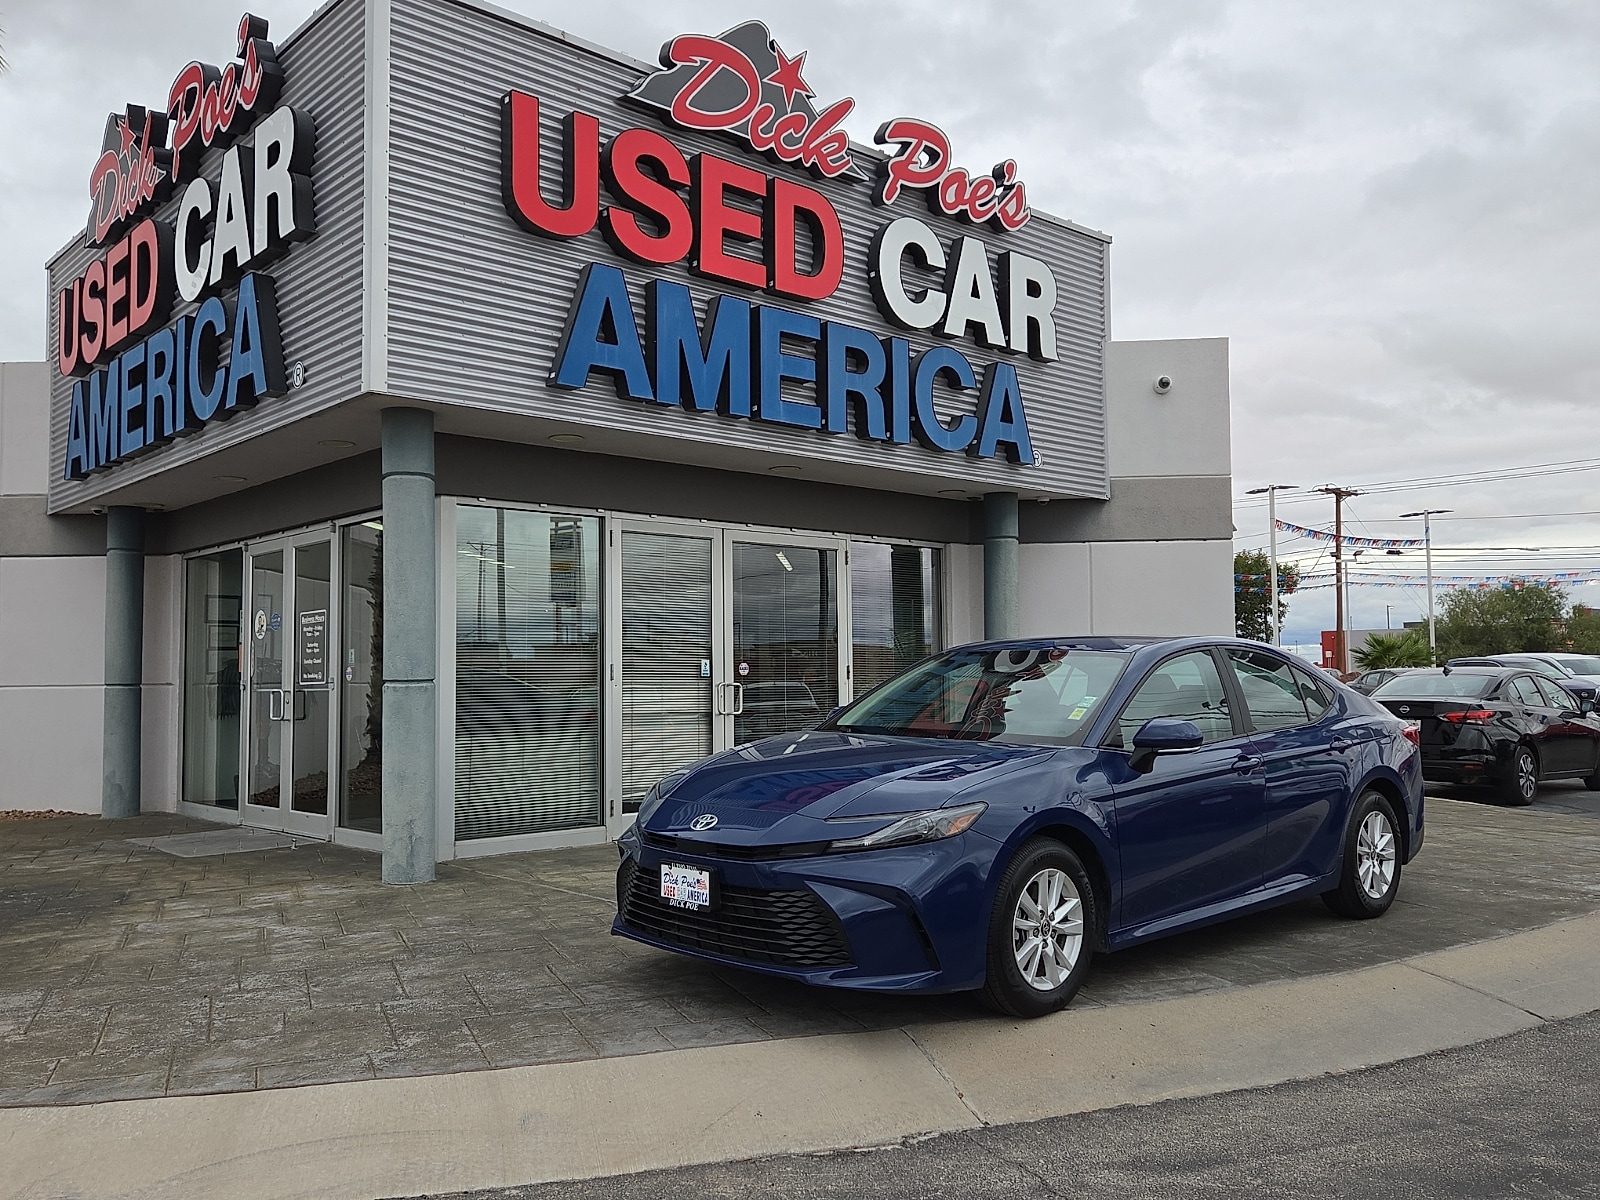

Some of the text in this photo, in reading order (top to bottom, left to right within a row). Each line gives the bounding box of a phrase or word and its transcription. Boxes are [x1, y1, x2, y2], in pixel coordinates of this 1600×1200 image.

[90, 12, 264, 244] Dick Poe's
[508, 89, 1060, 363] USED CAR
[669, 33, 1032, 233] Dick Poe's
[59, 104, 298, 377] USED CAR
[64, 272, 268, 481] AMERICA
[553, 261, 1035, 466] AMERICA
[669, 899, 699, 911] DICK POE
